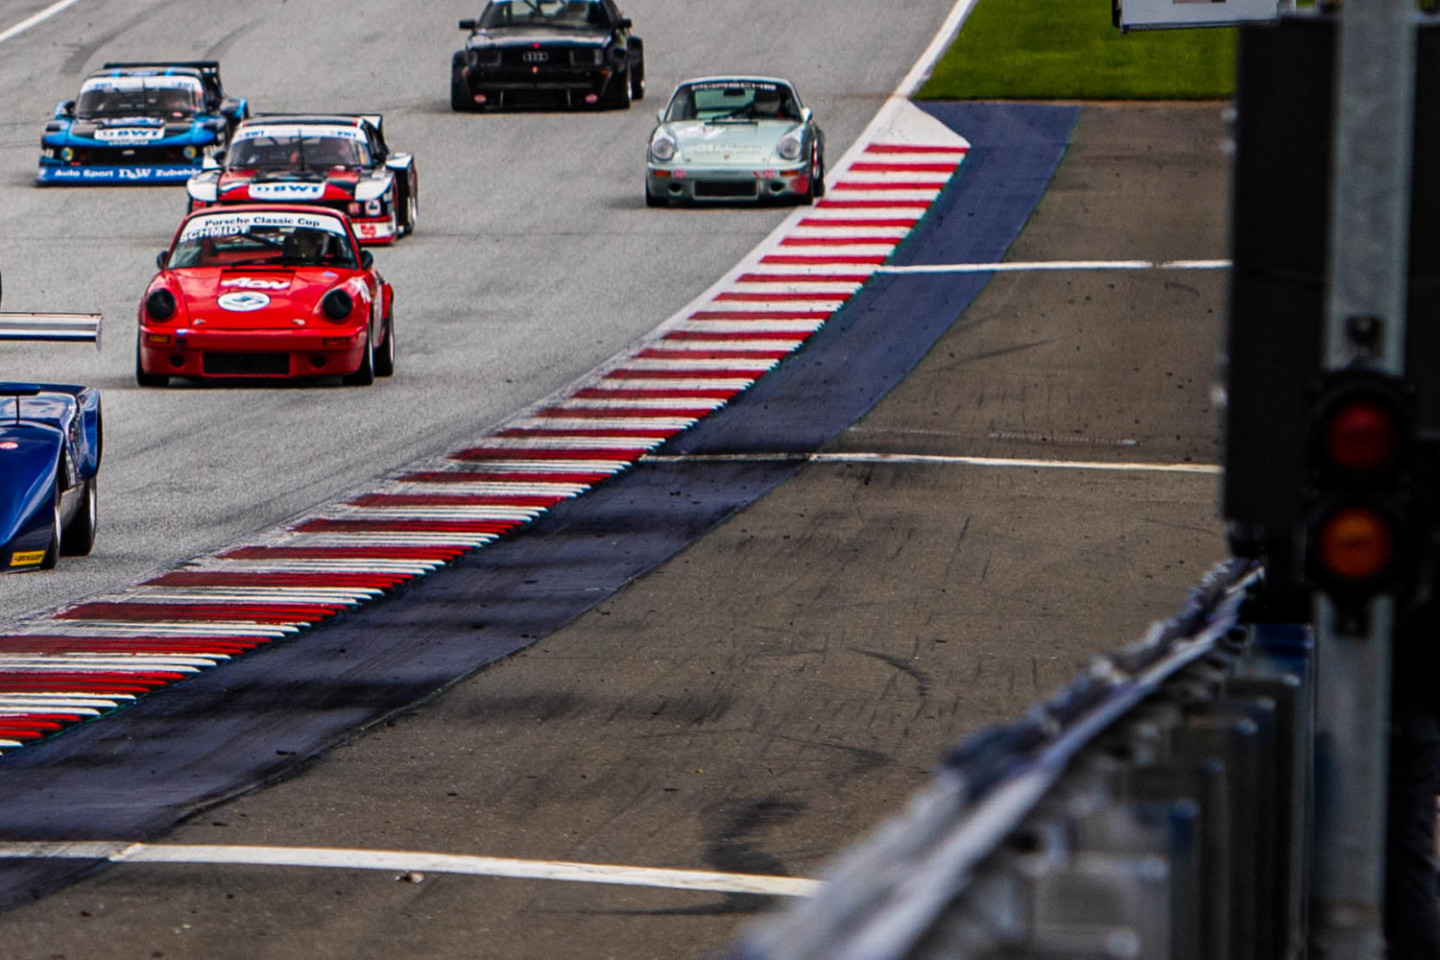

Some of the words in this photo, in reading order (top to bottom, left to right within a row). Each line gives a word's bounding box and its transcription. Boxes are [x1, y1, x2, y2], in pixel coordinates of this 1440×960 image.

[83, 169, 113, 178] Sport
[205, 217, 249, 227] Porsche
[253, 216, 294, 225] Classic
[297, 217, 320, 227] Cup
